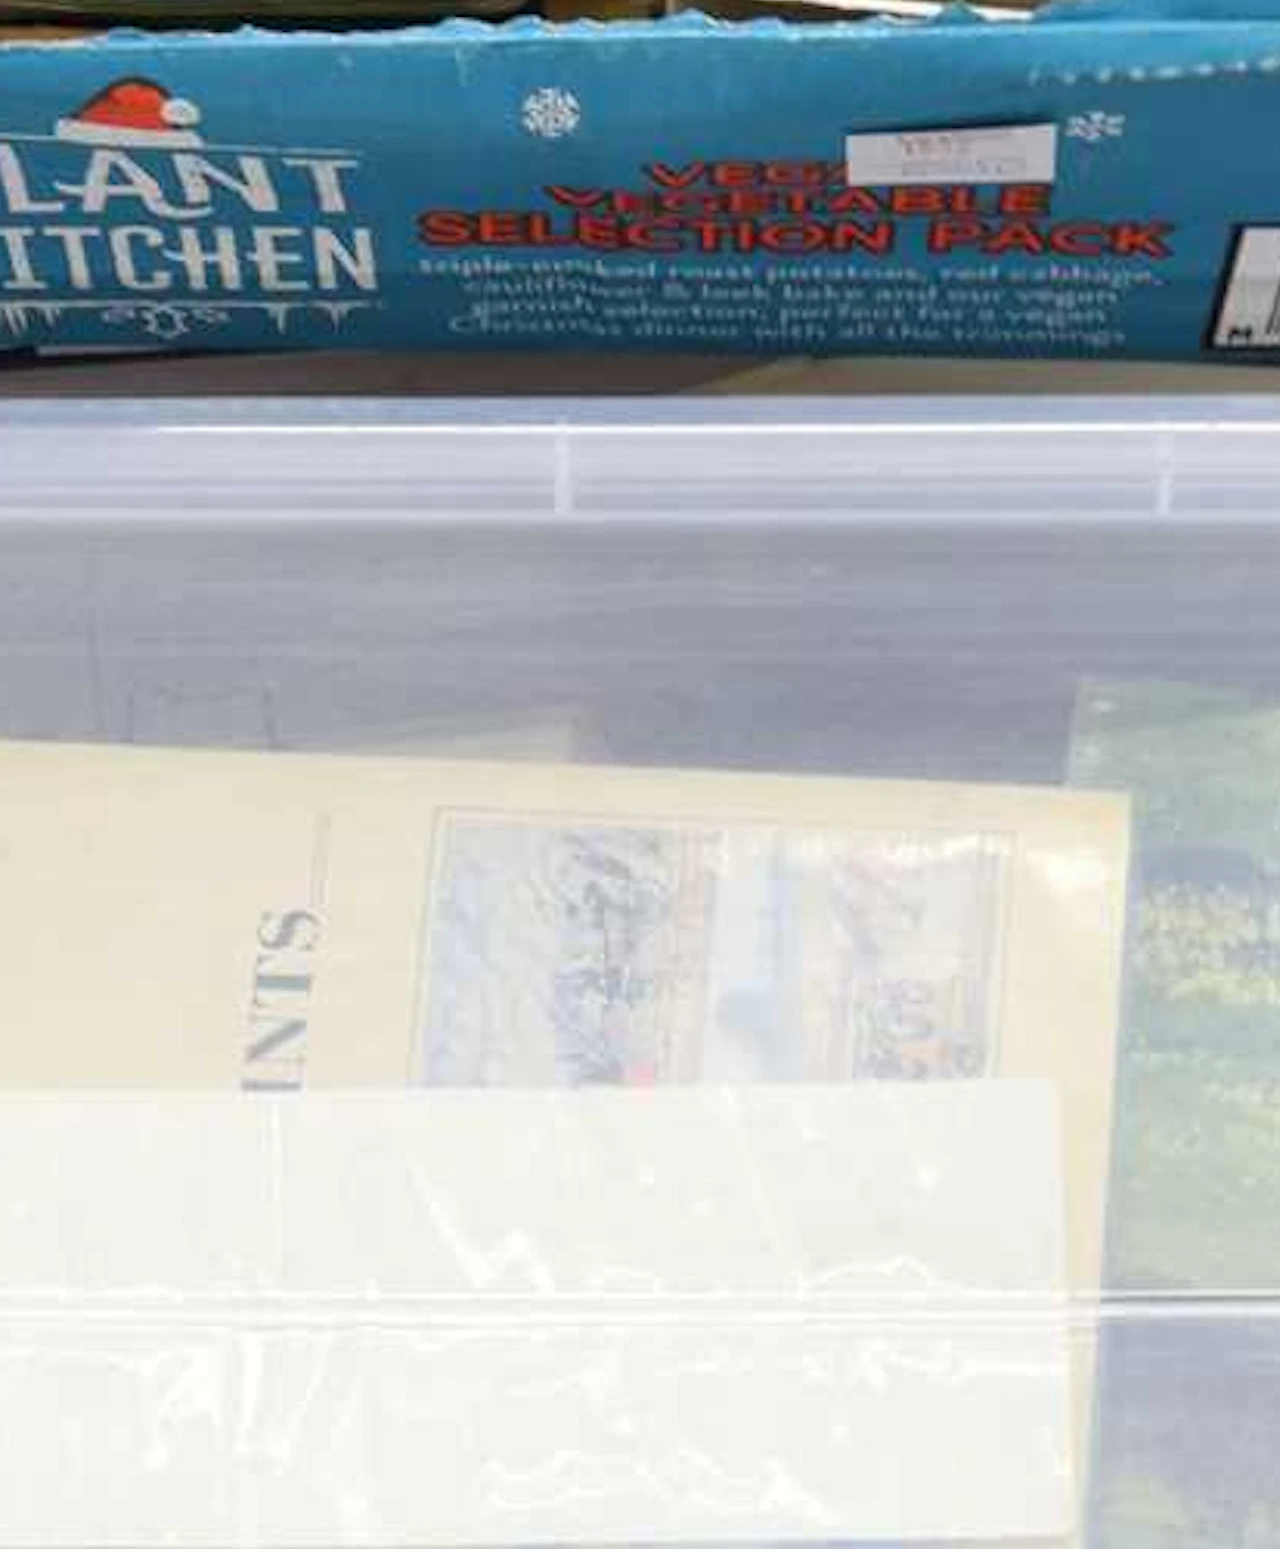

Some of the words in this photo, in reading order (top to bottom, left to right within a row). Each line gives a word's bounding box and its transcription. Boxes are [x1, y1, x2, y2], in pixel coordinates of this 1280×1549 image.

[542, 184, 1053, 218] VEGETABLE
[417, 208, 894, 255] SELECTION
[926, 220, 1174, 258] PACK
